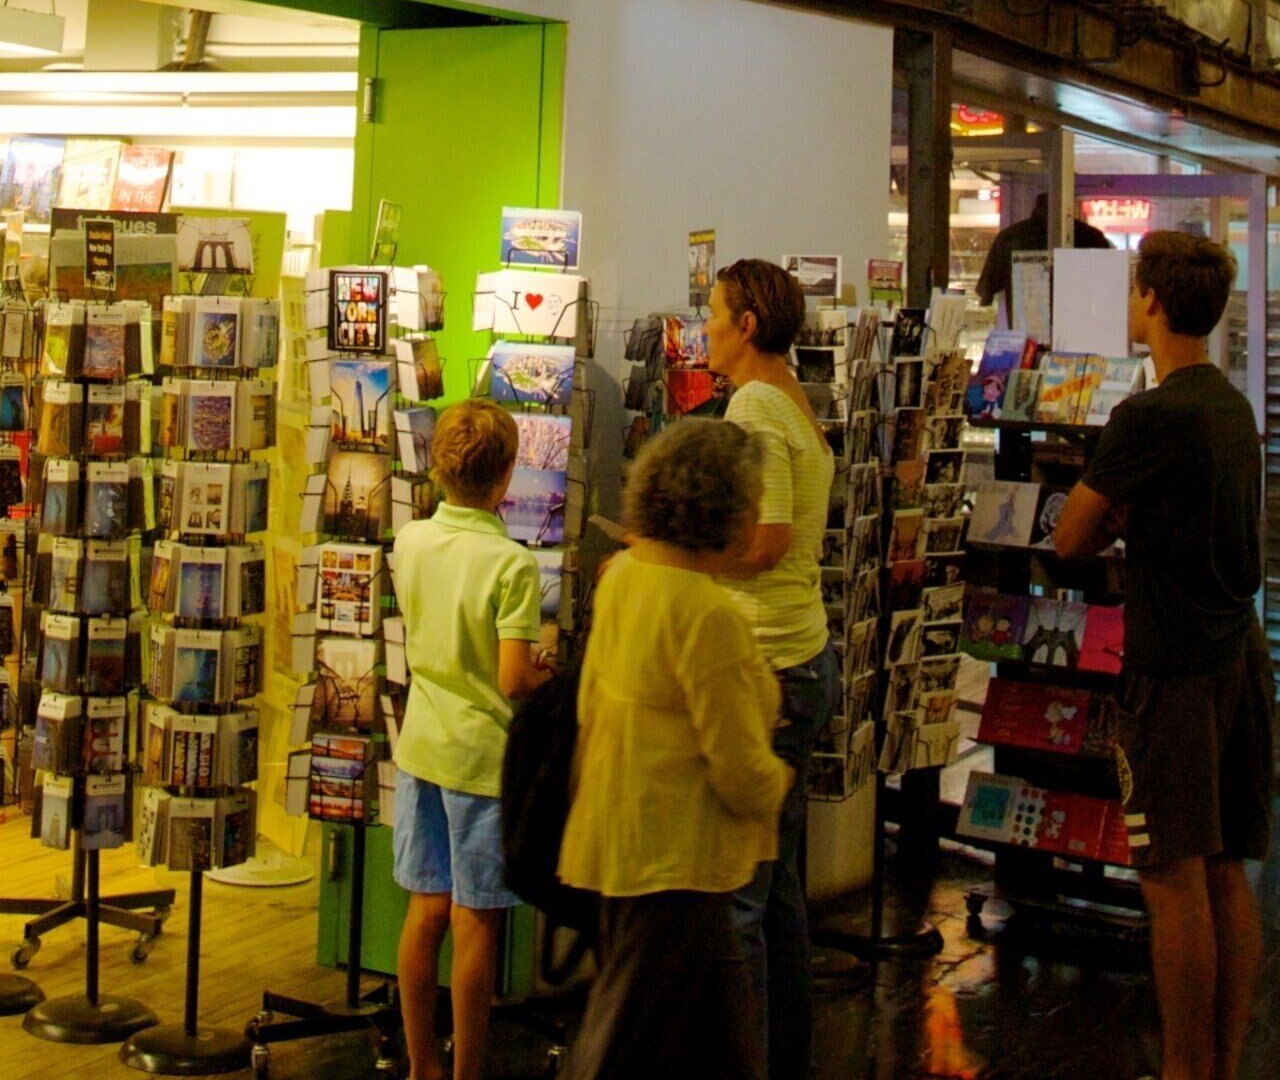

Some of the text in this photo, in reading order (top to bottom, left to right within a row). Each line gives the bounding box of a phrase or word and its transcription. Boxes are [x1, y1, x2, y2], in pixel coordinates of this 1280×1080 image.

[136, 190, 155, 205] THE
[77, 214, 158, 234] teues
[337, 276, 379, 301] NEW
[510, 291, 522, 310] I
[336, 301, 377, 322] YORK
[338, 322, 377, 346] CITY
